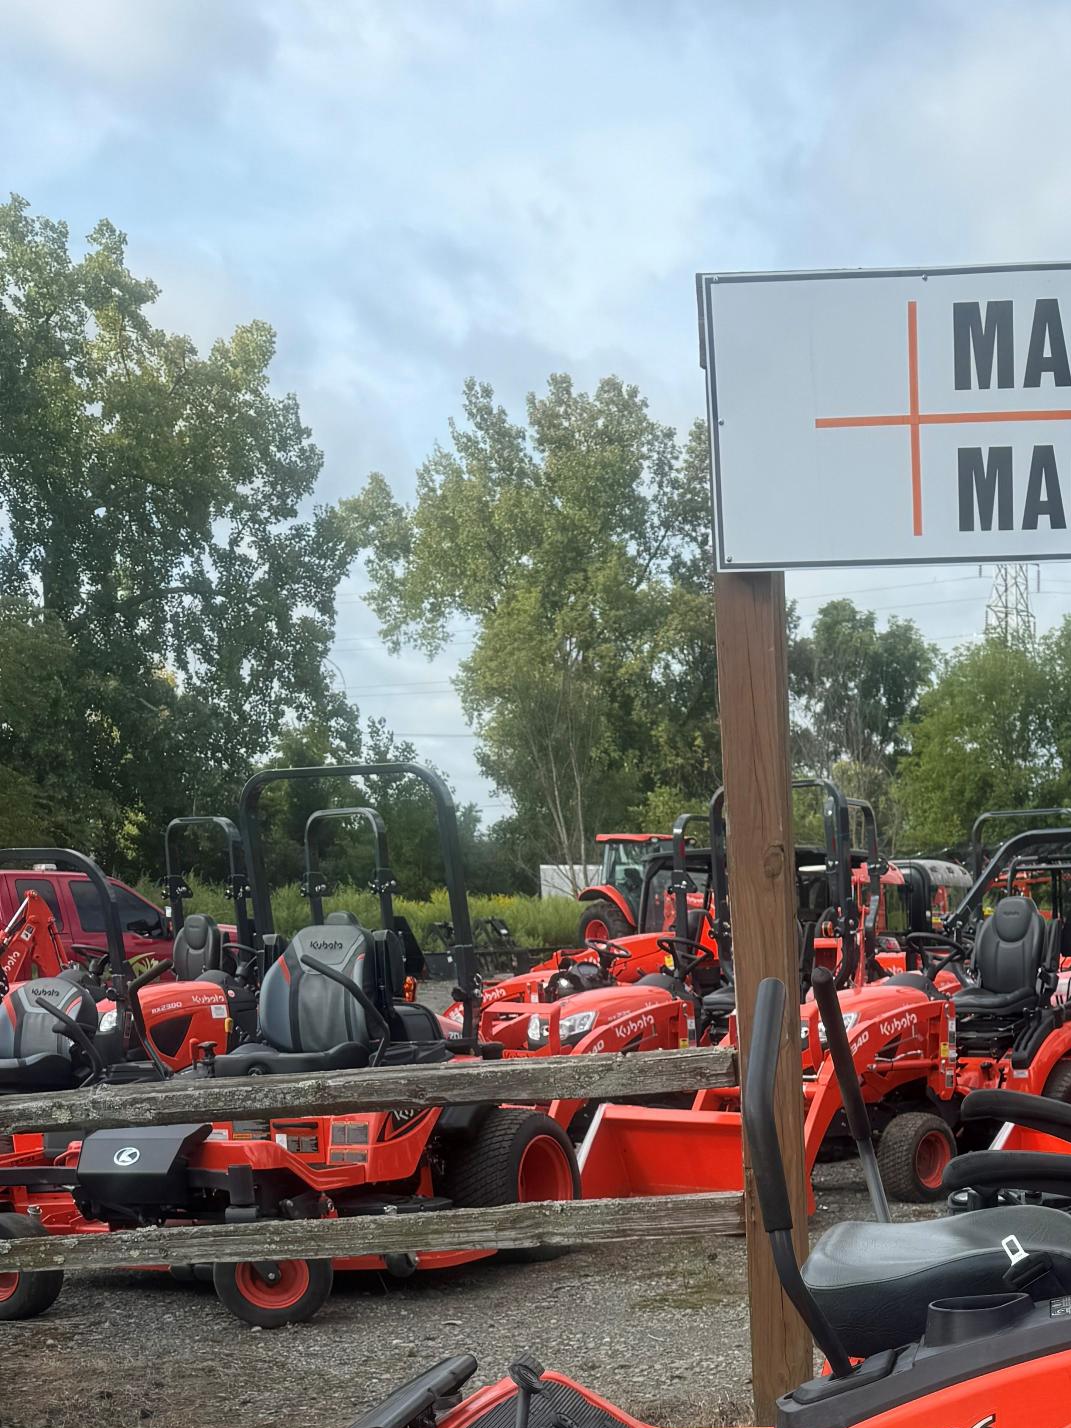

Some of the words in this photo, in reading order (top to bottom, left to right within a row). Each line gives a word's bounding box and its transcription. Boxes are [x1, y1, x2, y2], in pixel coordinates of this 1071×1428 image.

[309, 940, 344, 950] Kubota
[31, 988, 60, 997] Kubota
[191, 994, 225, 1004] Kubota
[615, 1014, 655, 1038] Kubota
[880, 1012, 918, 1036] Kubota
